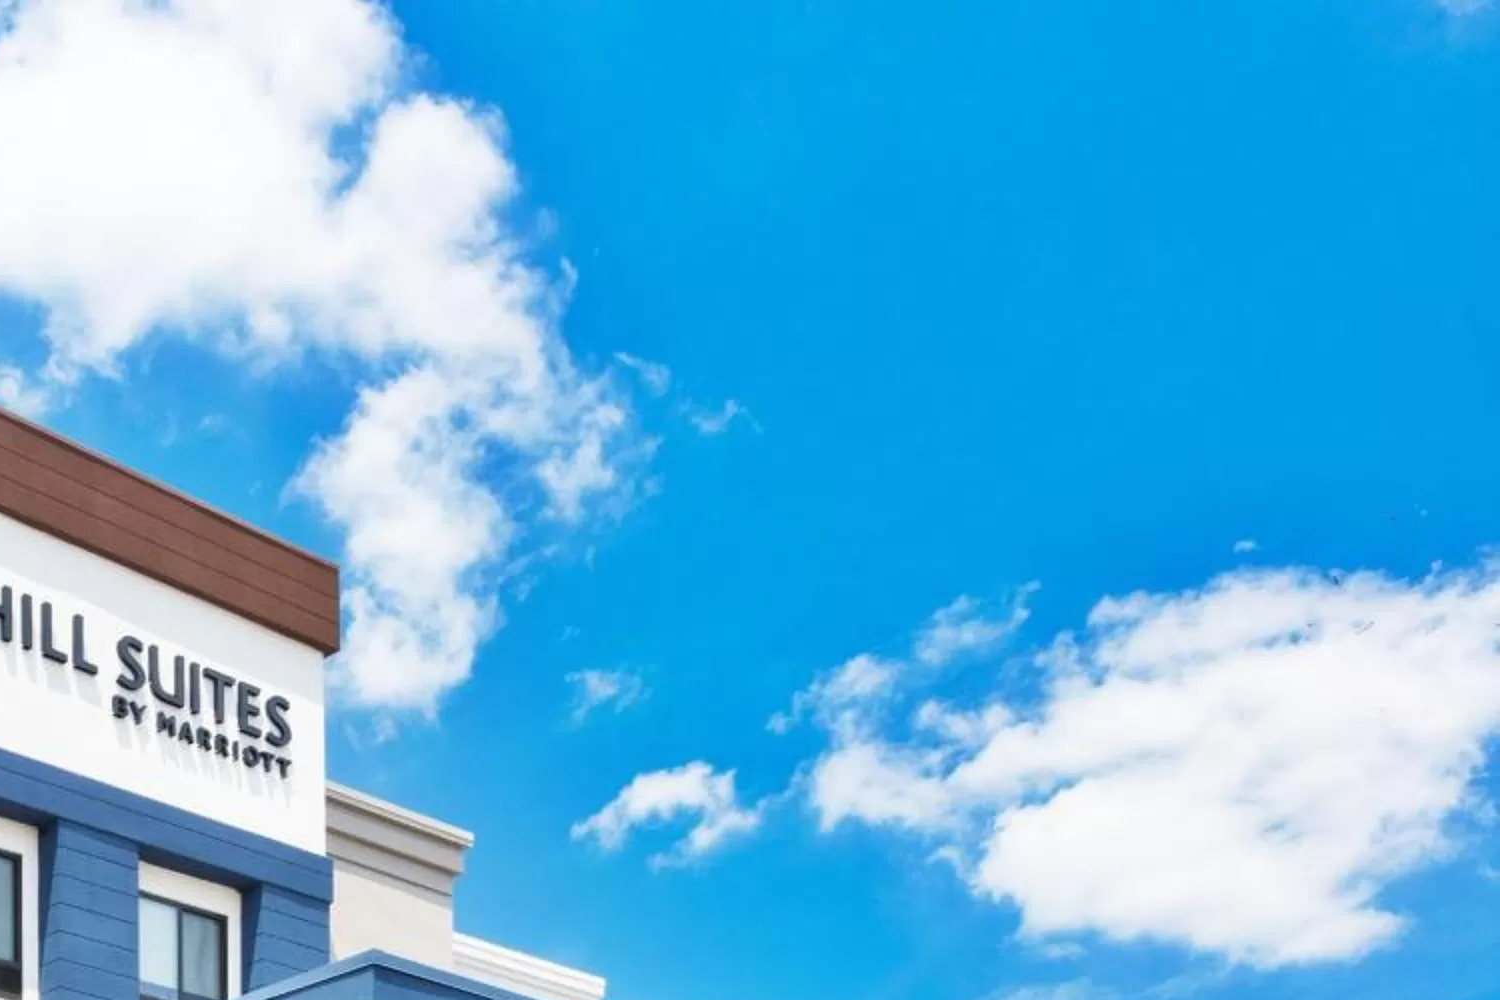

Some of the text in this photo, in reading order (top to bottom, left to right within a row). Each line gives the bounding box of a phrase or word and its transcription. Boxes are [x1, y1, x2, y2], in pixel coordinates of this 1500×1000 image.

[112, 695, 292, 779] BY MARRIOTT
[115, 635, 292, 749] SUITES
